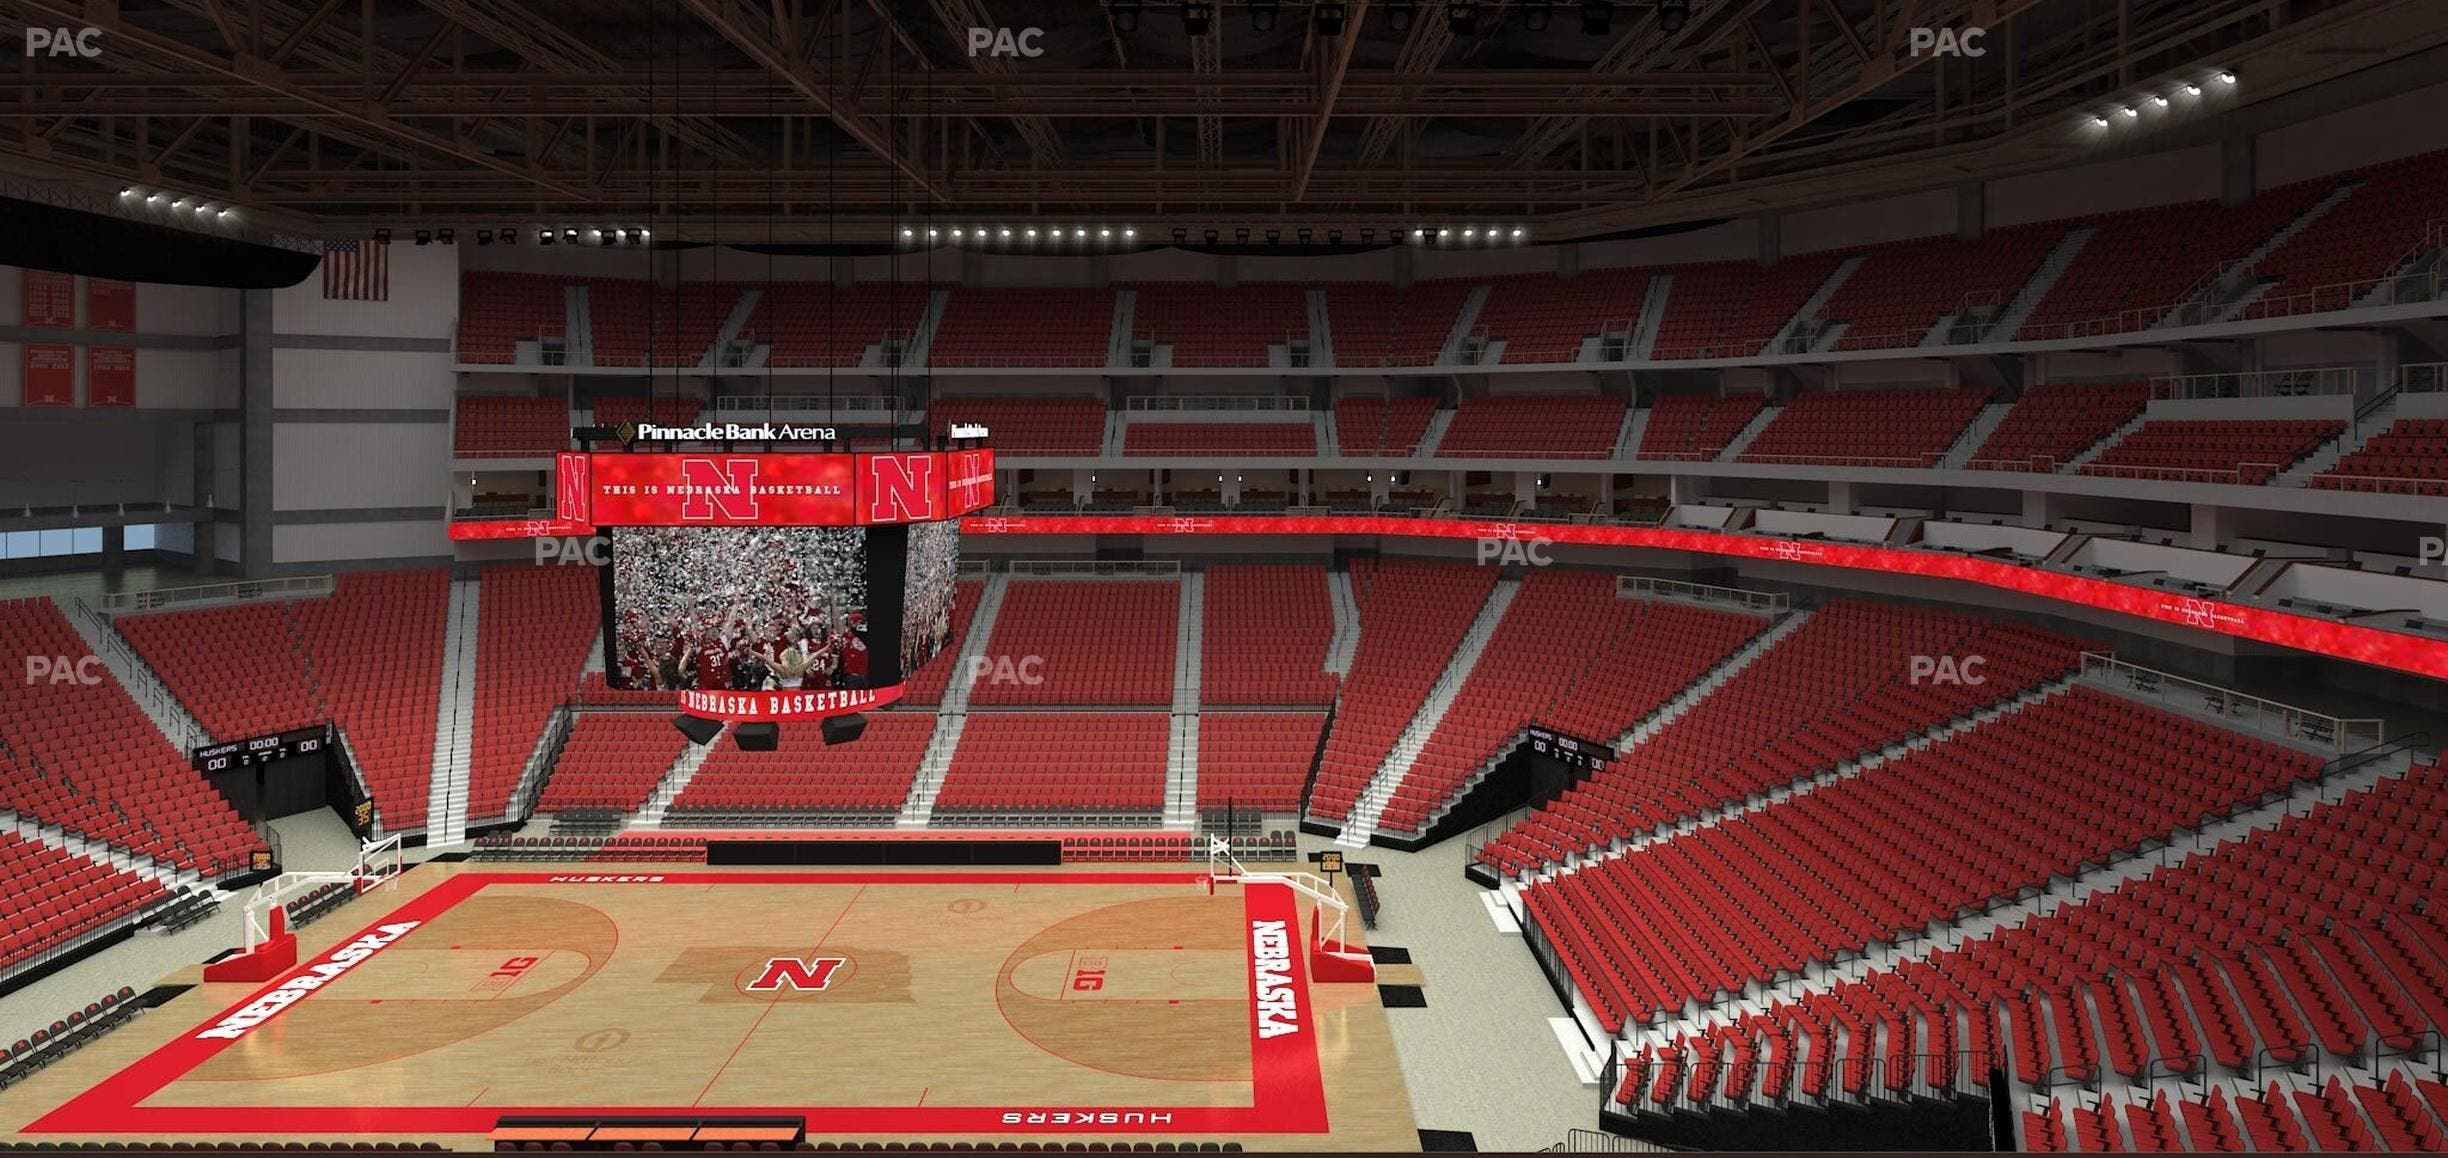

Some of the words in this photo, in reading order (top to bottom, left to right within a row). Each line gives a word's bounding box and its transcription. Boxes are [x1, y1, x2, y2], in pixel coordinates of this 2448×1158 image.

[638, 422, 726, 441] Pinnacle
[726, 422, 777, 441] Bank
[777, 423, 836, 441] Arena
[561, 454, 585, 522] N
[602, 485, 636, 495] THIS
[644, 485, 658, 495] IS
[666, 485, 741, 495] NEBRASKA
[750, 485, 841, 495] BASKETBALL
[682, 458, 759, 519] N
[872, 455, 932, 522] N
[688, 691, 758, 715] NEBRASKA
[769, 690, 876, 714] BASKETBALL
[200, 744, 238, 758] HUSKERS
[300, 739, 318, 752] 00
[207, 757, 227, 771] 00
[195, 920, 422, 1039] NEBRASKA
[745, 957, 847, 991] N
[1252, 920, 1299, 1039] NEBRASKA
[1002, 1112, 1172, 1124] HUSKERS
